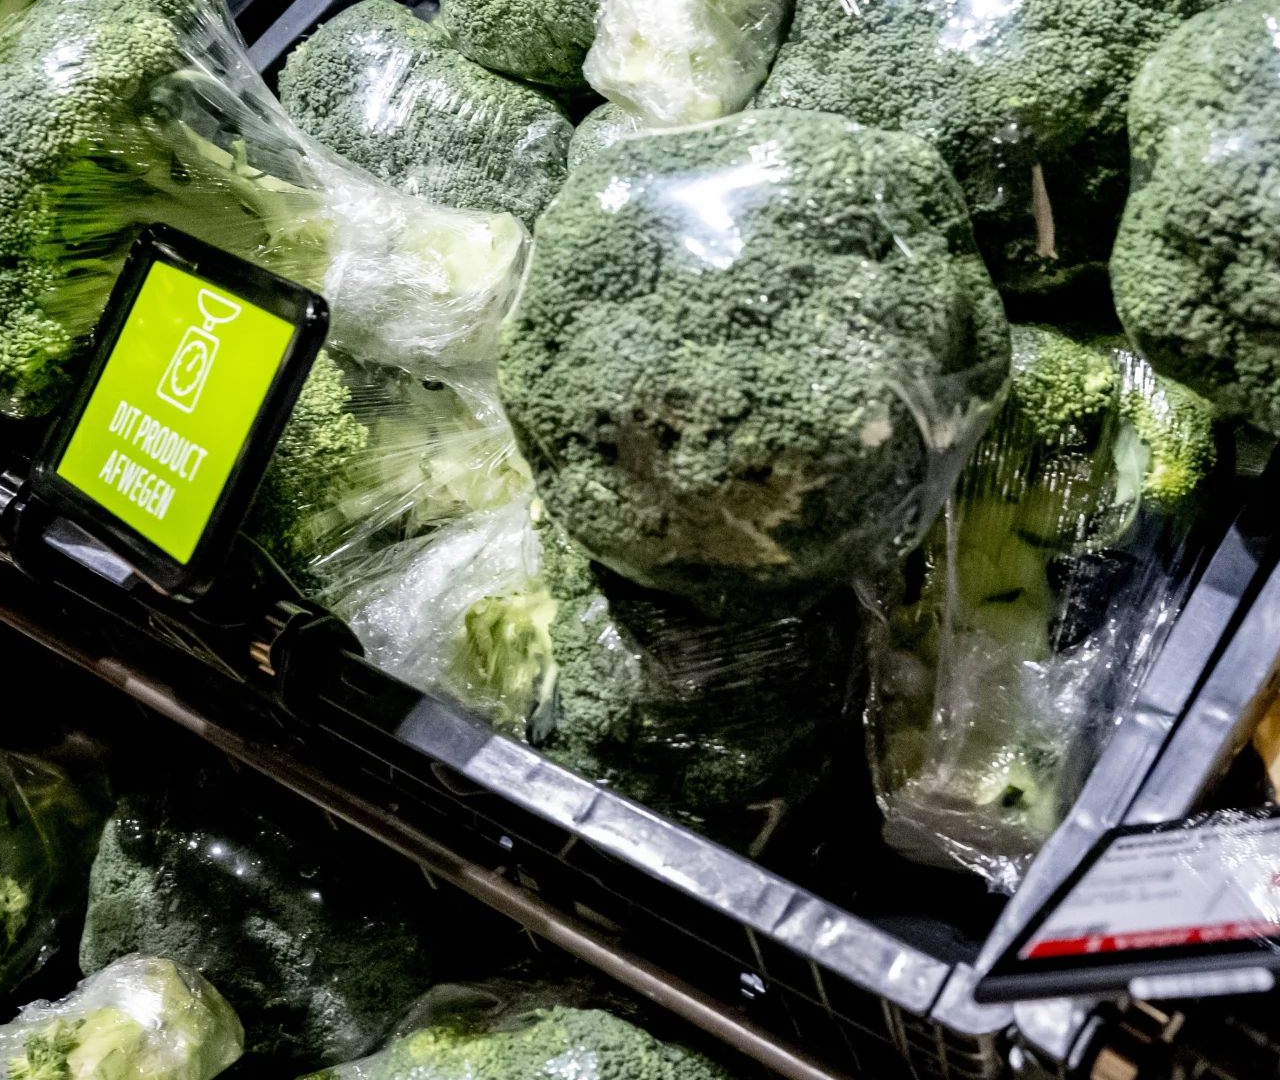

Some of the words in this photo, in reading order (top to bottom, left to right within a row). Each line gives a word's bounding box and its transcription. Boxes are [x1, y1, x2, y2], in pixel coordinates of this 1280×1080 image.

[109, 400, 142, 440] DIT
[132, 414, 209, 482] PRODUCT
[98, 449, 176, 520] AFWEGEN
